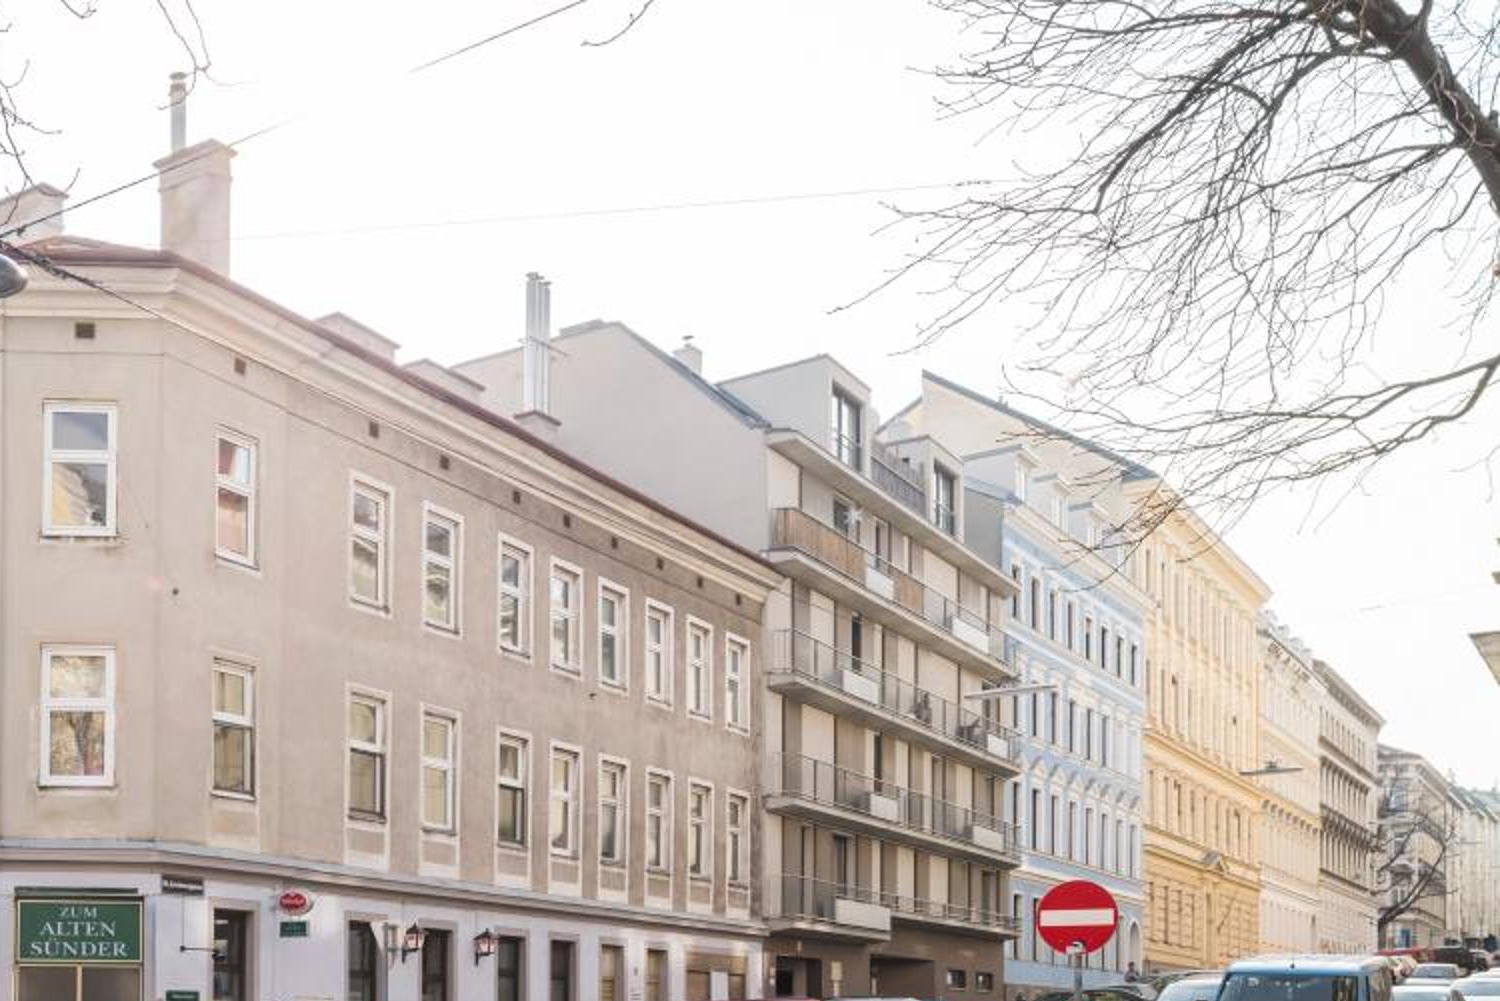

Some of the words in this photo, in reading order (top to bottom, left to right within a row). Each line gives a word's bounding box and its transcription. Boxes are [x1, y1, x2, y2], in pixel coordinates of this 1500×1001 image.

[59, 906, 98, 919] ZUM
[40, 921, 116, 937] ALTEN
[30, 937, 129, 957] SÜNDER
